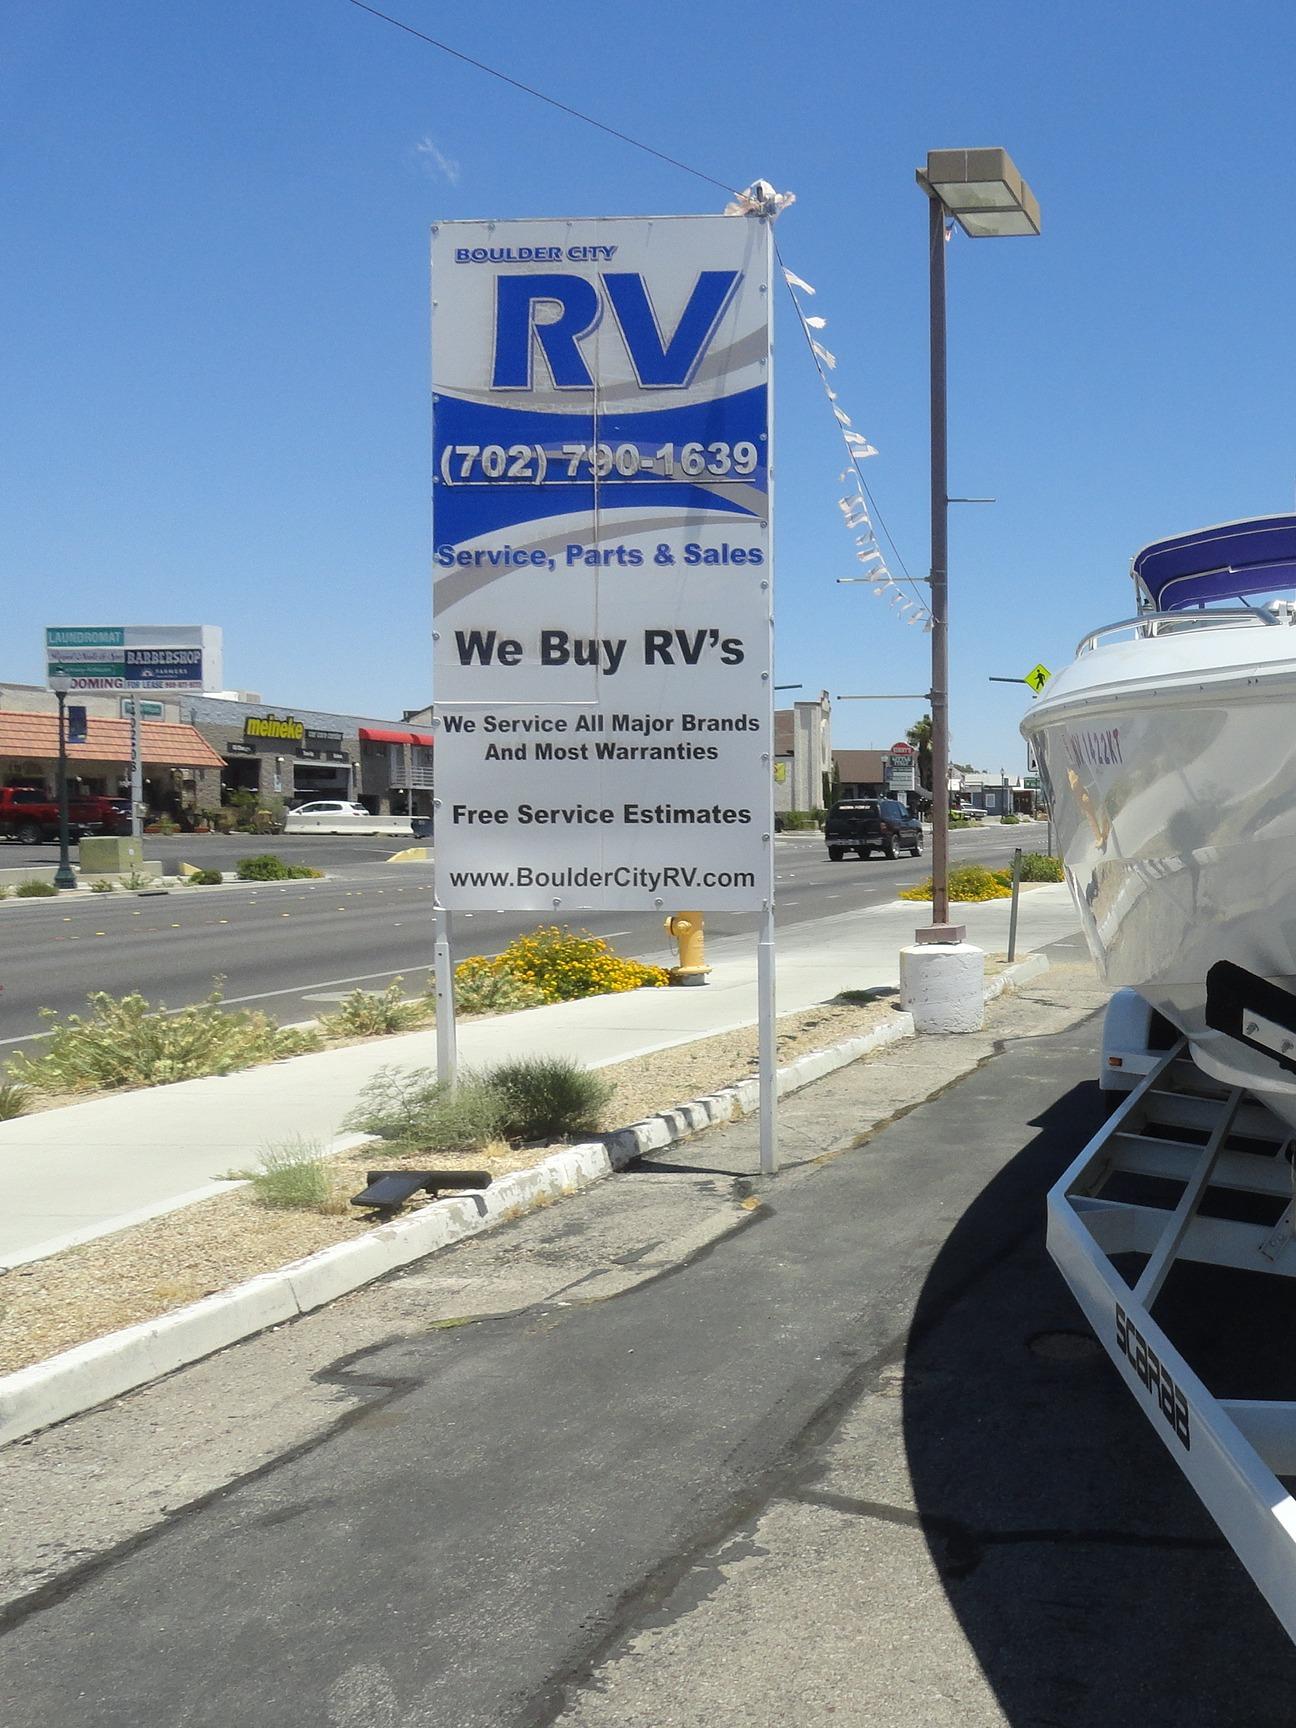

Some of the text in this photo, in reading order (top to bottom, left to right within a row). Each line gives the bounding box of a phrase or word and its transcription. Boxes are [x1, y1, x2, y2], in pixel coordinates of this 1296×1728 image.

[455, 245, 618, 262] BOULDER CITY
[490, 270, 743, 391] RV
[441, 441, 758, 487] (702) 790-1639
[437, 543, 764, 569] Service, Parts & Sales
[50, 631, 121, 643] LAUNDROMAT
[127, 651, 200, 664] BARBERSHOP
[454, 629, 745, 675] We Buy RV's
[247, 715, 304, 739] meineke
[443, 714, 760, 736] We Service All Major Brands
[485, 742, 718, 761] And Most Warranties
[453, 804, 751, 824] Free Service Estimates
[450, 866, 755, 892] www.BoulderCityRV.com
